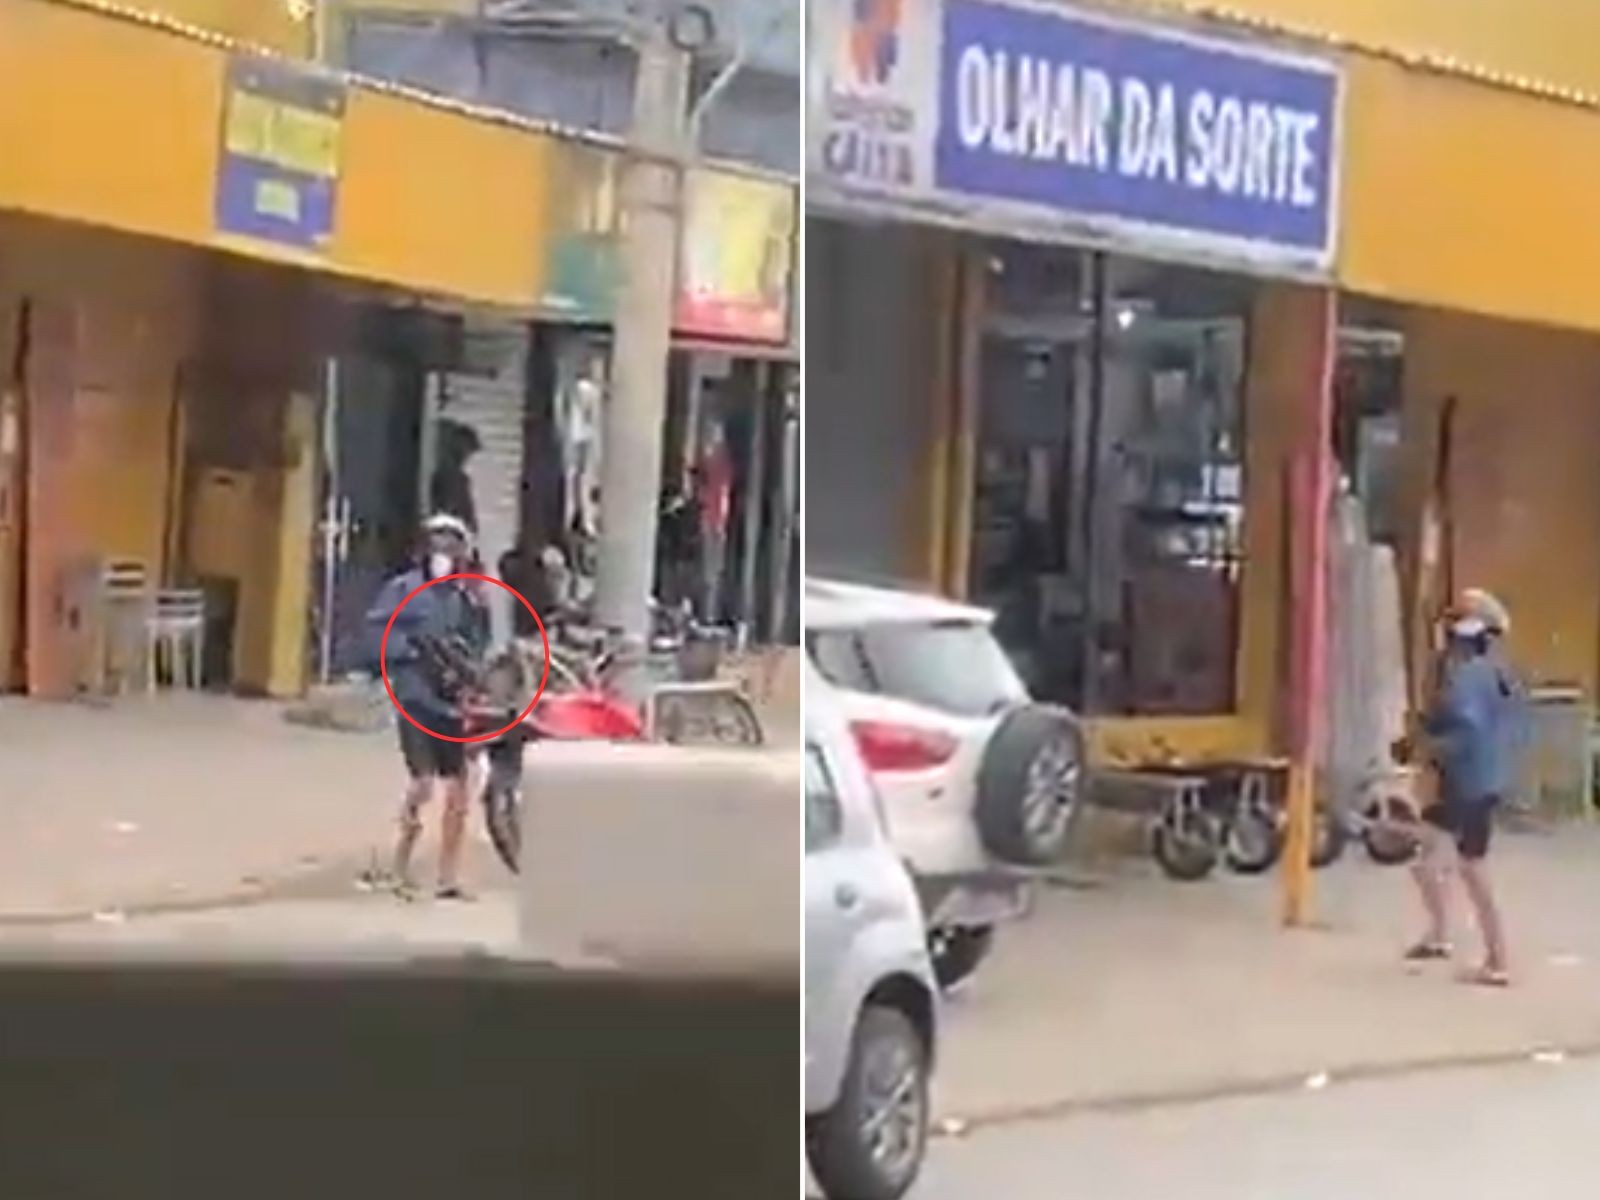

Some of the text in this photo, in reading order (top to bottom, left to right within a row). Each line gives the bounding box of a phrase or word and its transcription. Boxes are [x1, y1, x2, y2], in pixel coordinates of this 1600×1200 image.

[957, 44, 1111, 172] OLHAR
[1118, 76, 1177, 181] DA
[1186, 87, 1318, 206] SORTE
